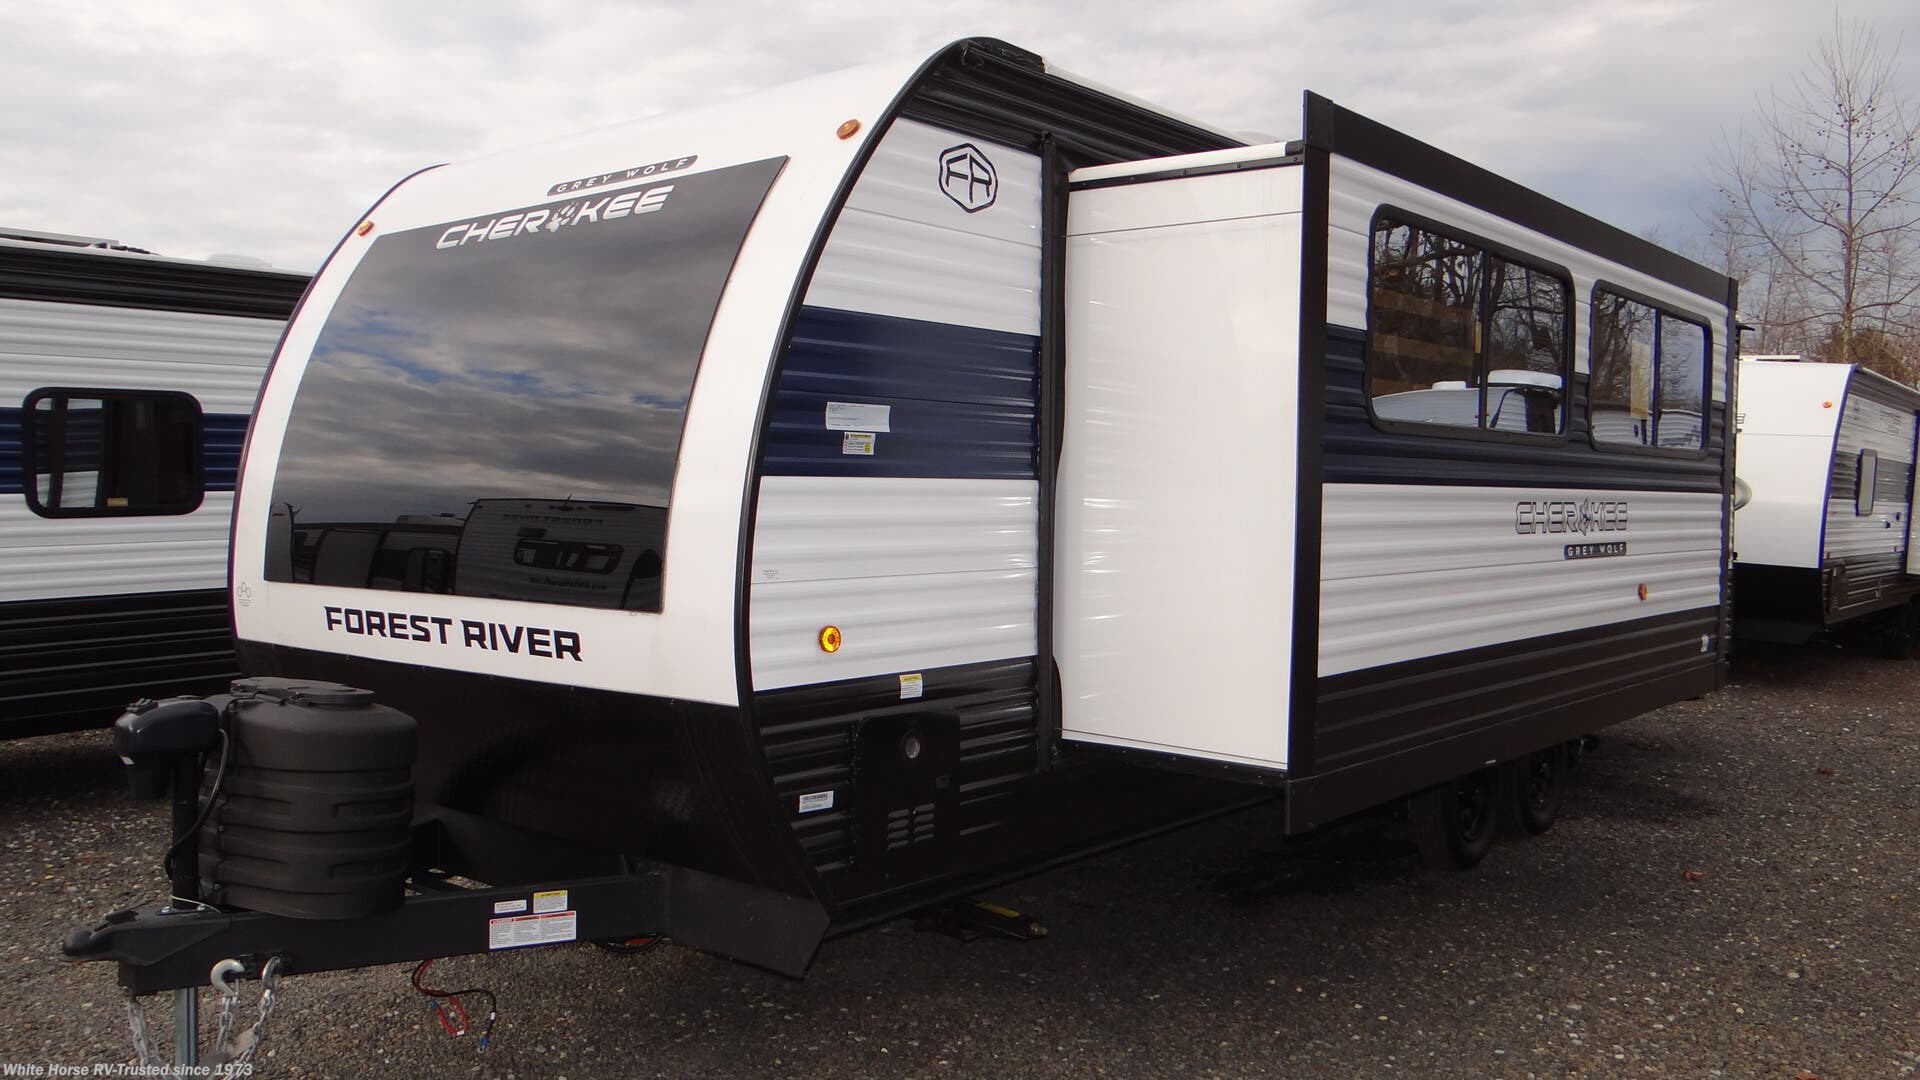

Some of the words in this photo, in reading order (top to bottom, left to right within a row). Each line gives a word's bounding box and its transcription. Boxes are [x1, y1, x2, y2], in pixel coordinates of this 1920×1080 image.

[556, 174, 613, 194] GREY
[625, 158, 689, 178] WOLF
[1567, 546, 1594, 557] GREY
[1599, 543, 1625, 554] WOLF
[323, 605, 453, 645] FOREST
[460, 619, 583, 662] RIVER
